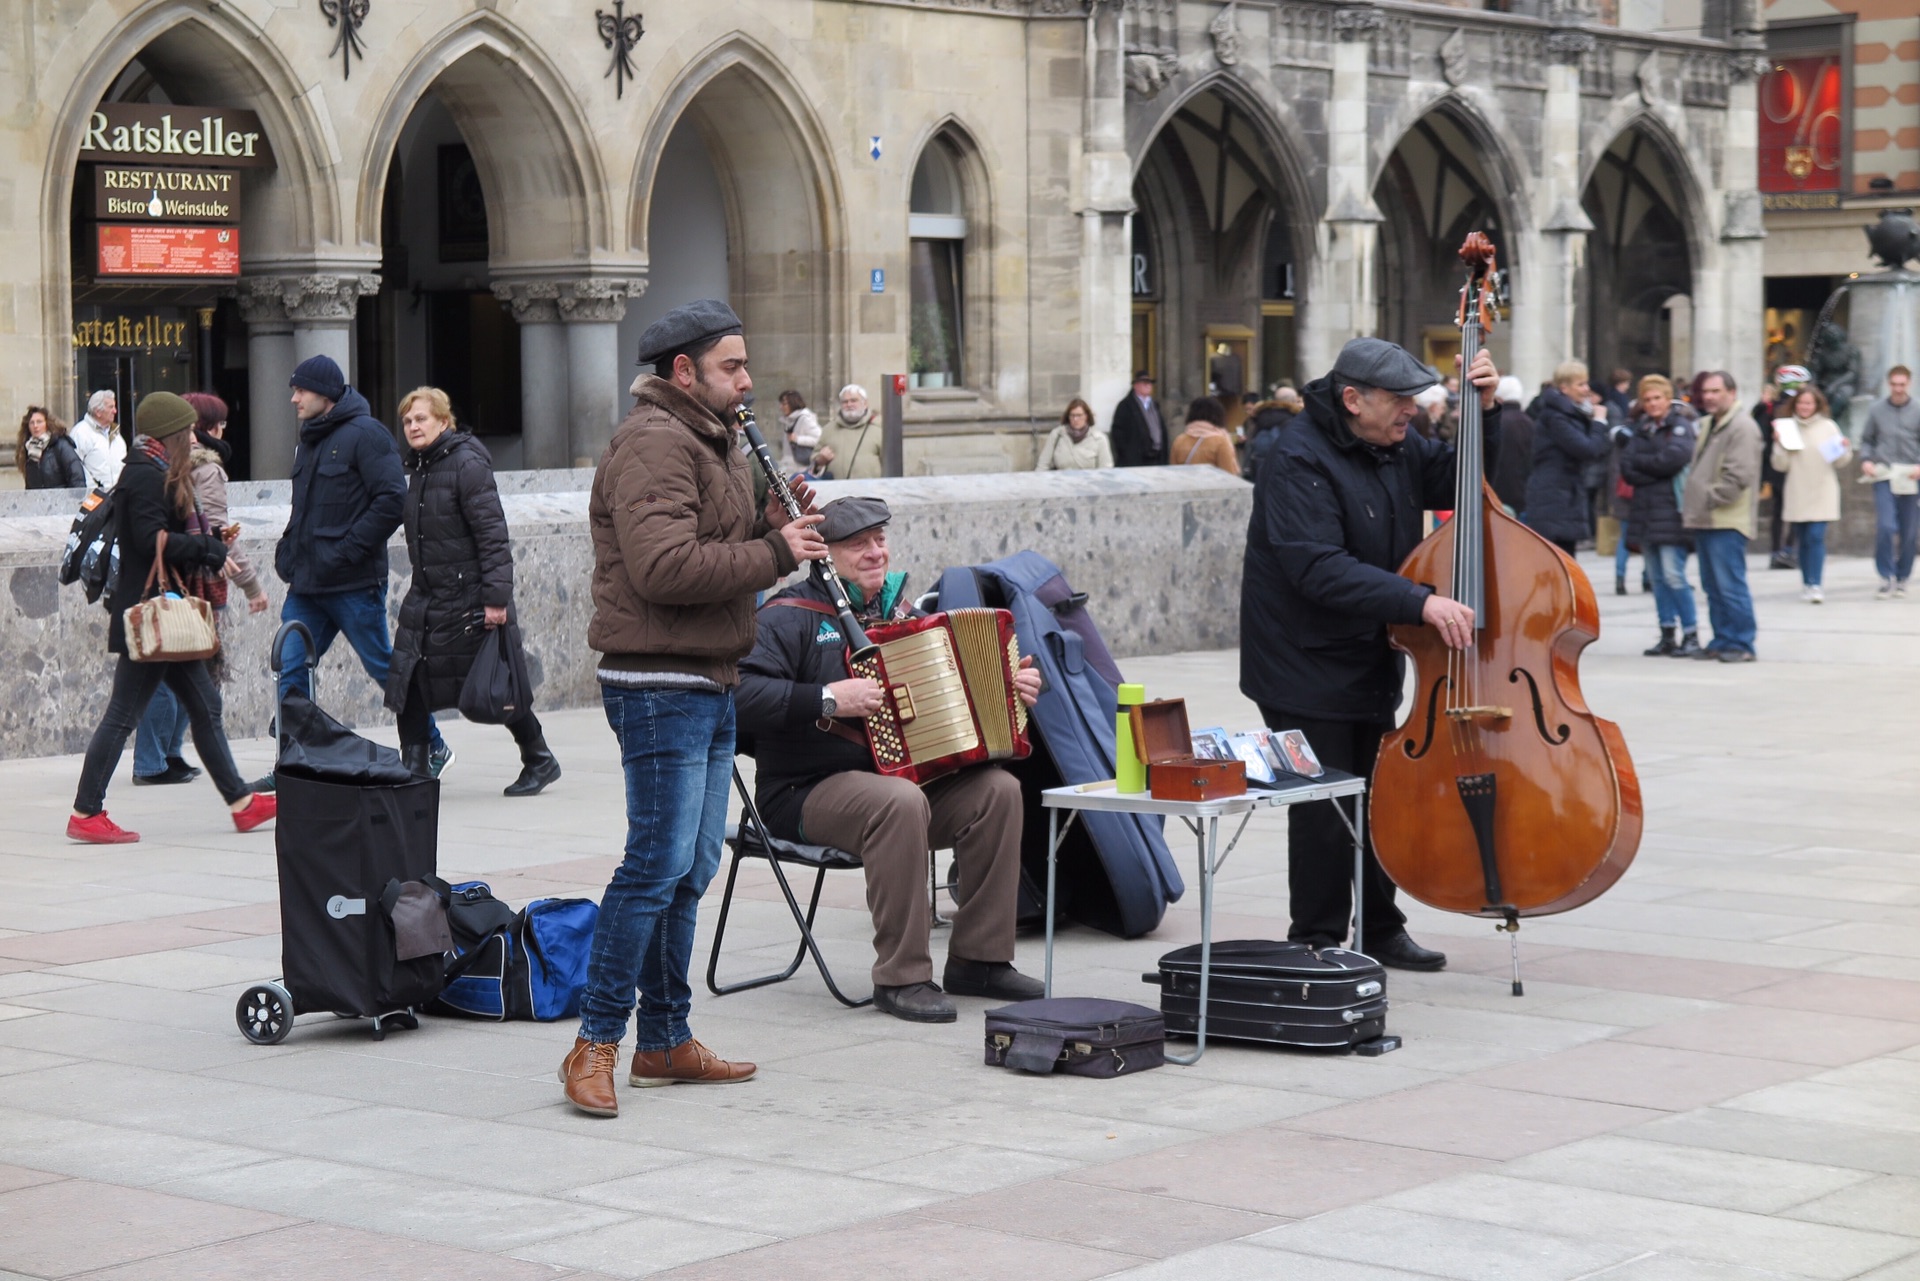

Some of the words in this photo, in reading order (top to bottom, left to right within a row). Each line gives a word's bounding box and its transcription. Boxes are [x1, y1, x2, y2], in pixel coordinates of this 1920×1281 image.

[81, 111, 260, 157] Ratskeller
[104, 170, 232, 192] RESTAURANT
[108, 197, 145, 214] Bistro
[165, 200, 229, 217] Weinstube
[73, 315, 185, 347] atskeller
[816, 631, 841, 642] adidas
